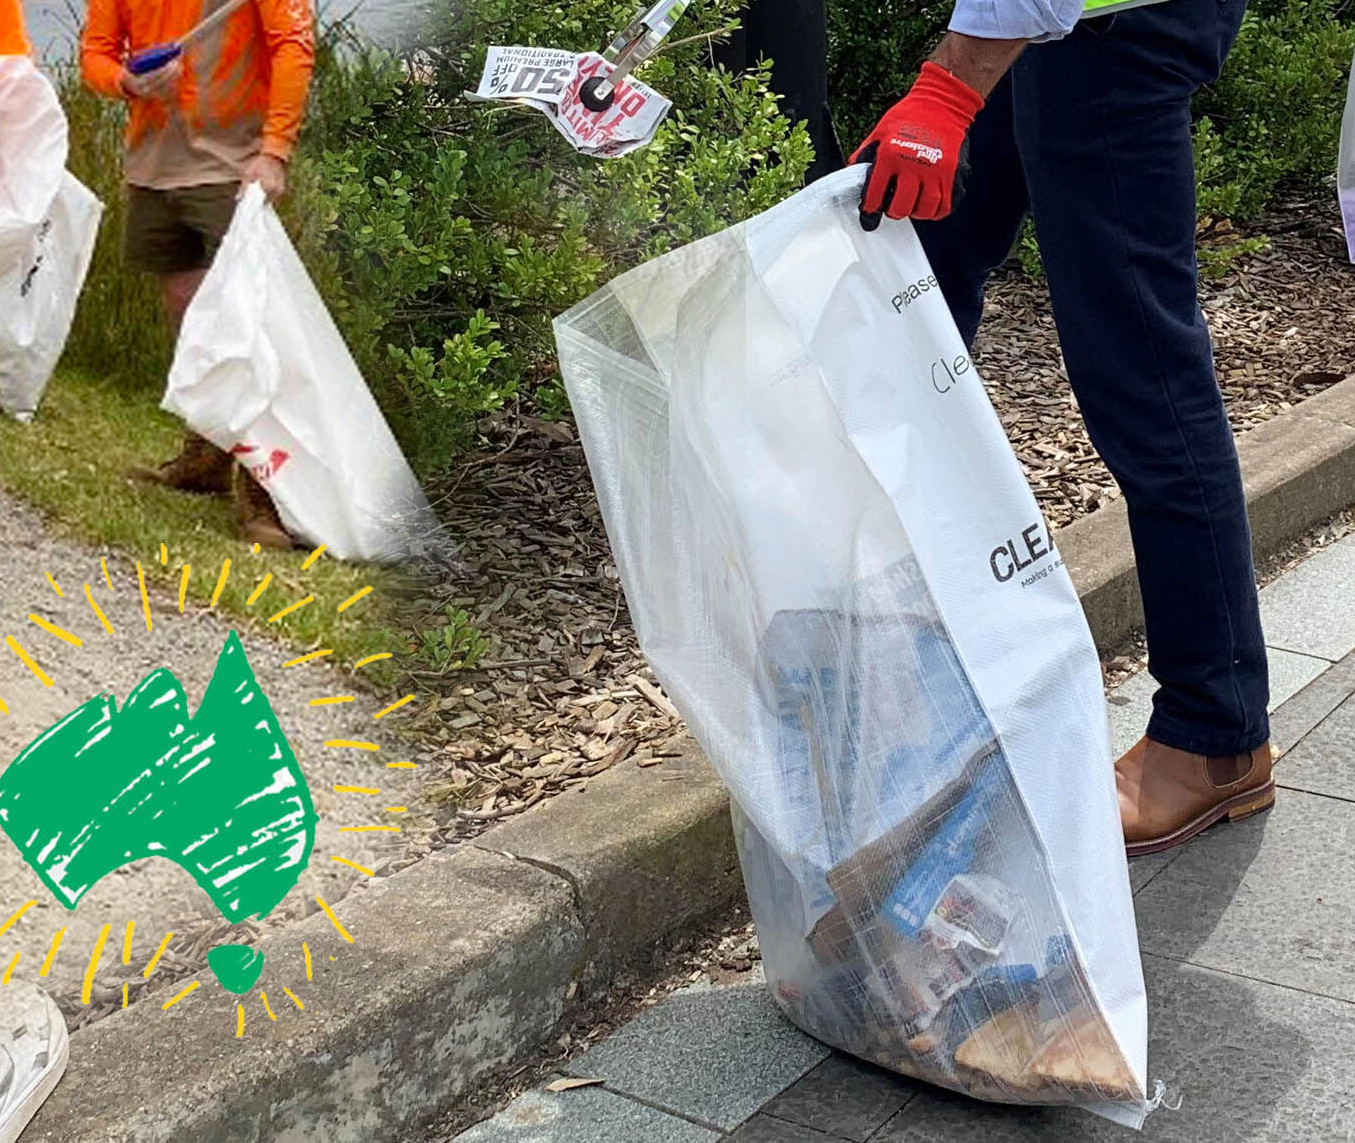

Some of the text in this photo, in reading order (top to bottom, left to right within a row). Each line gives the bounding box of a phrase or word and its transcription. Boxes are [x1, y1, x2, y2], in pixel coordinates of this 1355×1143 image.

[491, 63, 518, 76] OFF
[542, 58, 574, 68] LARGE
[578, 56, 646, 118] ONY!
